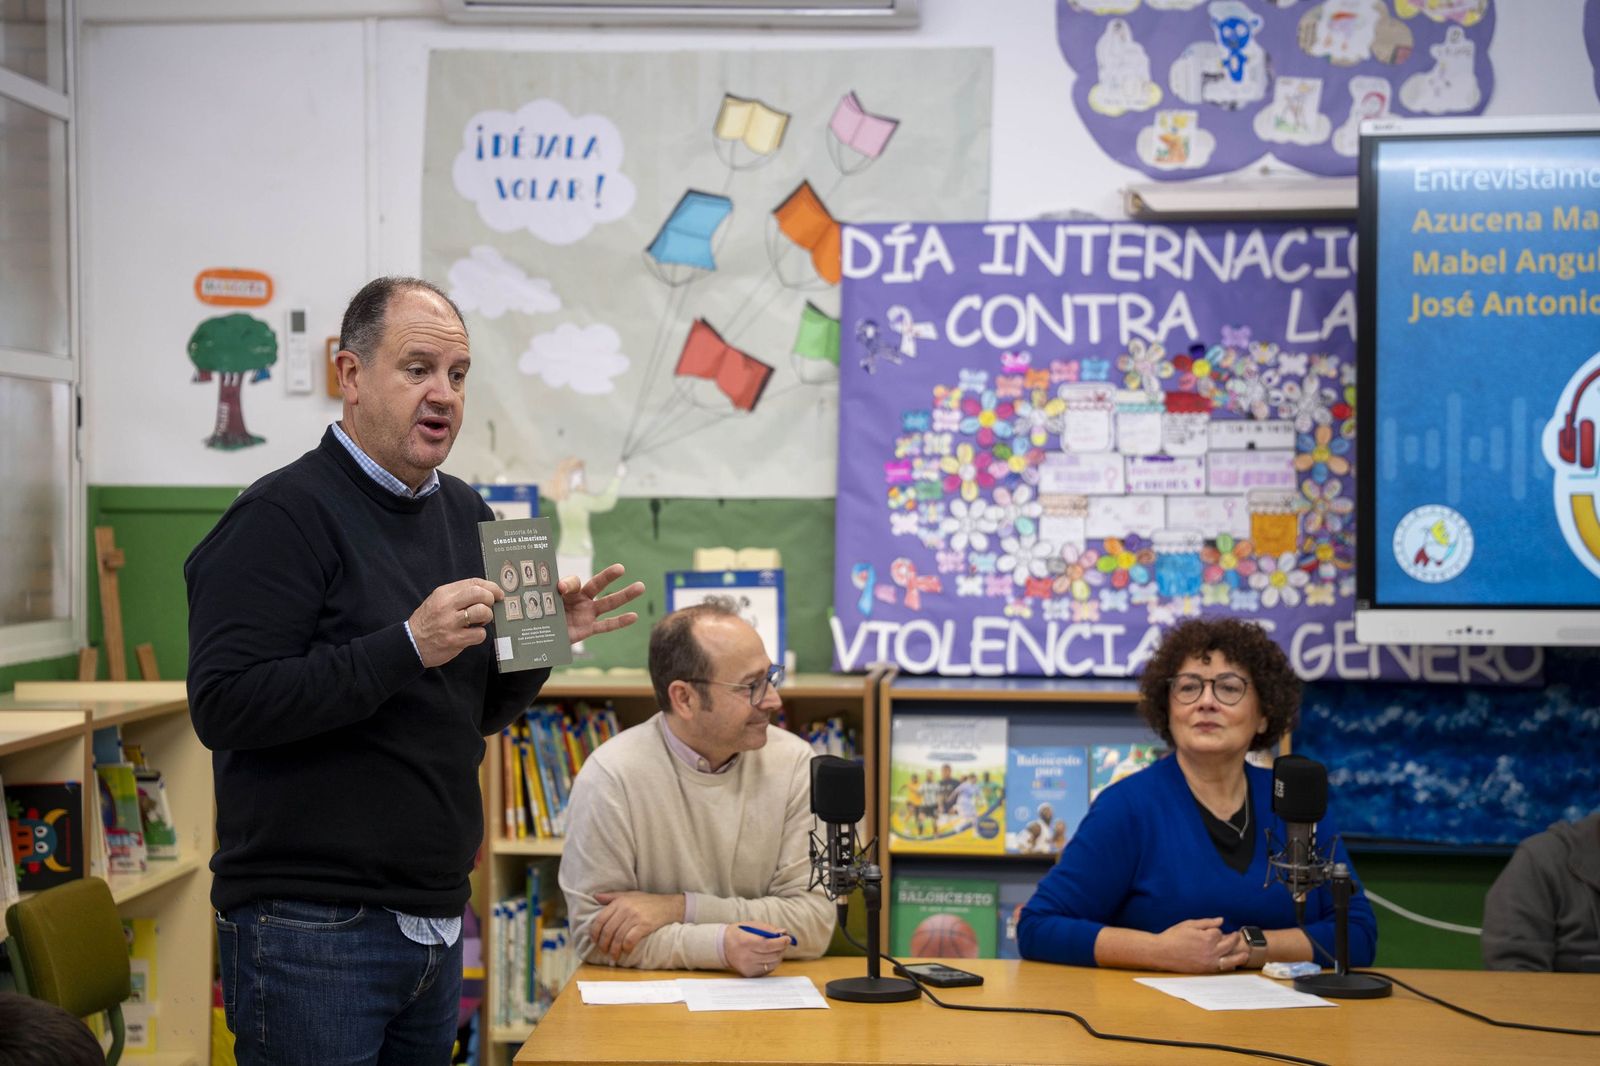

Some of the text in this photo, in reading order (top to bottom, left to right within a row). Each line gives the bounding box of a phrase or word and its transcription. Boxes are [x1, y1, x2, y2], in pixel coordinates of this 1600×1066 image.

[476, 124, 602, 160] ¡DÉJALA
[1414, 164, 1600, 192] Entrevistamo
[1411, 205, 1600, 234] Azucena Ma
[841, 223, 1357, 283] DÍA INTERNACI
[1413, 248, 1507, 276] Mabel
[946, 289, 1357, 348] CONTRA LA
[1408, 288, 1600, 324] José Antonio
[493, 535, 548, 545] ciencia almeriense
[504, 529, 526, 537] Historia
[506, 544, 526, 552] nombre
[533, 542, 548, 550] mujer
[898, 890, 993, 906] BALONCESTO
